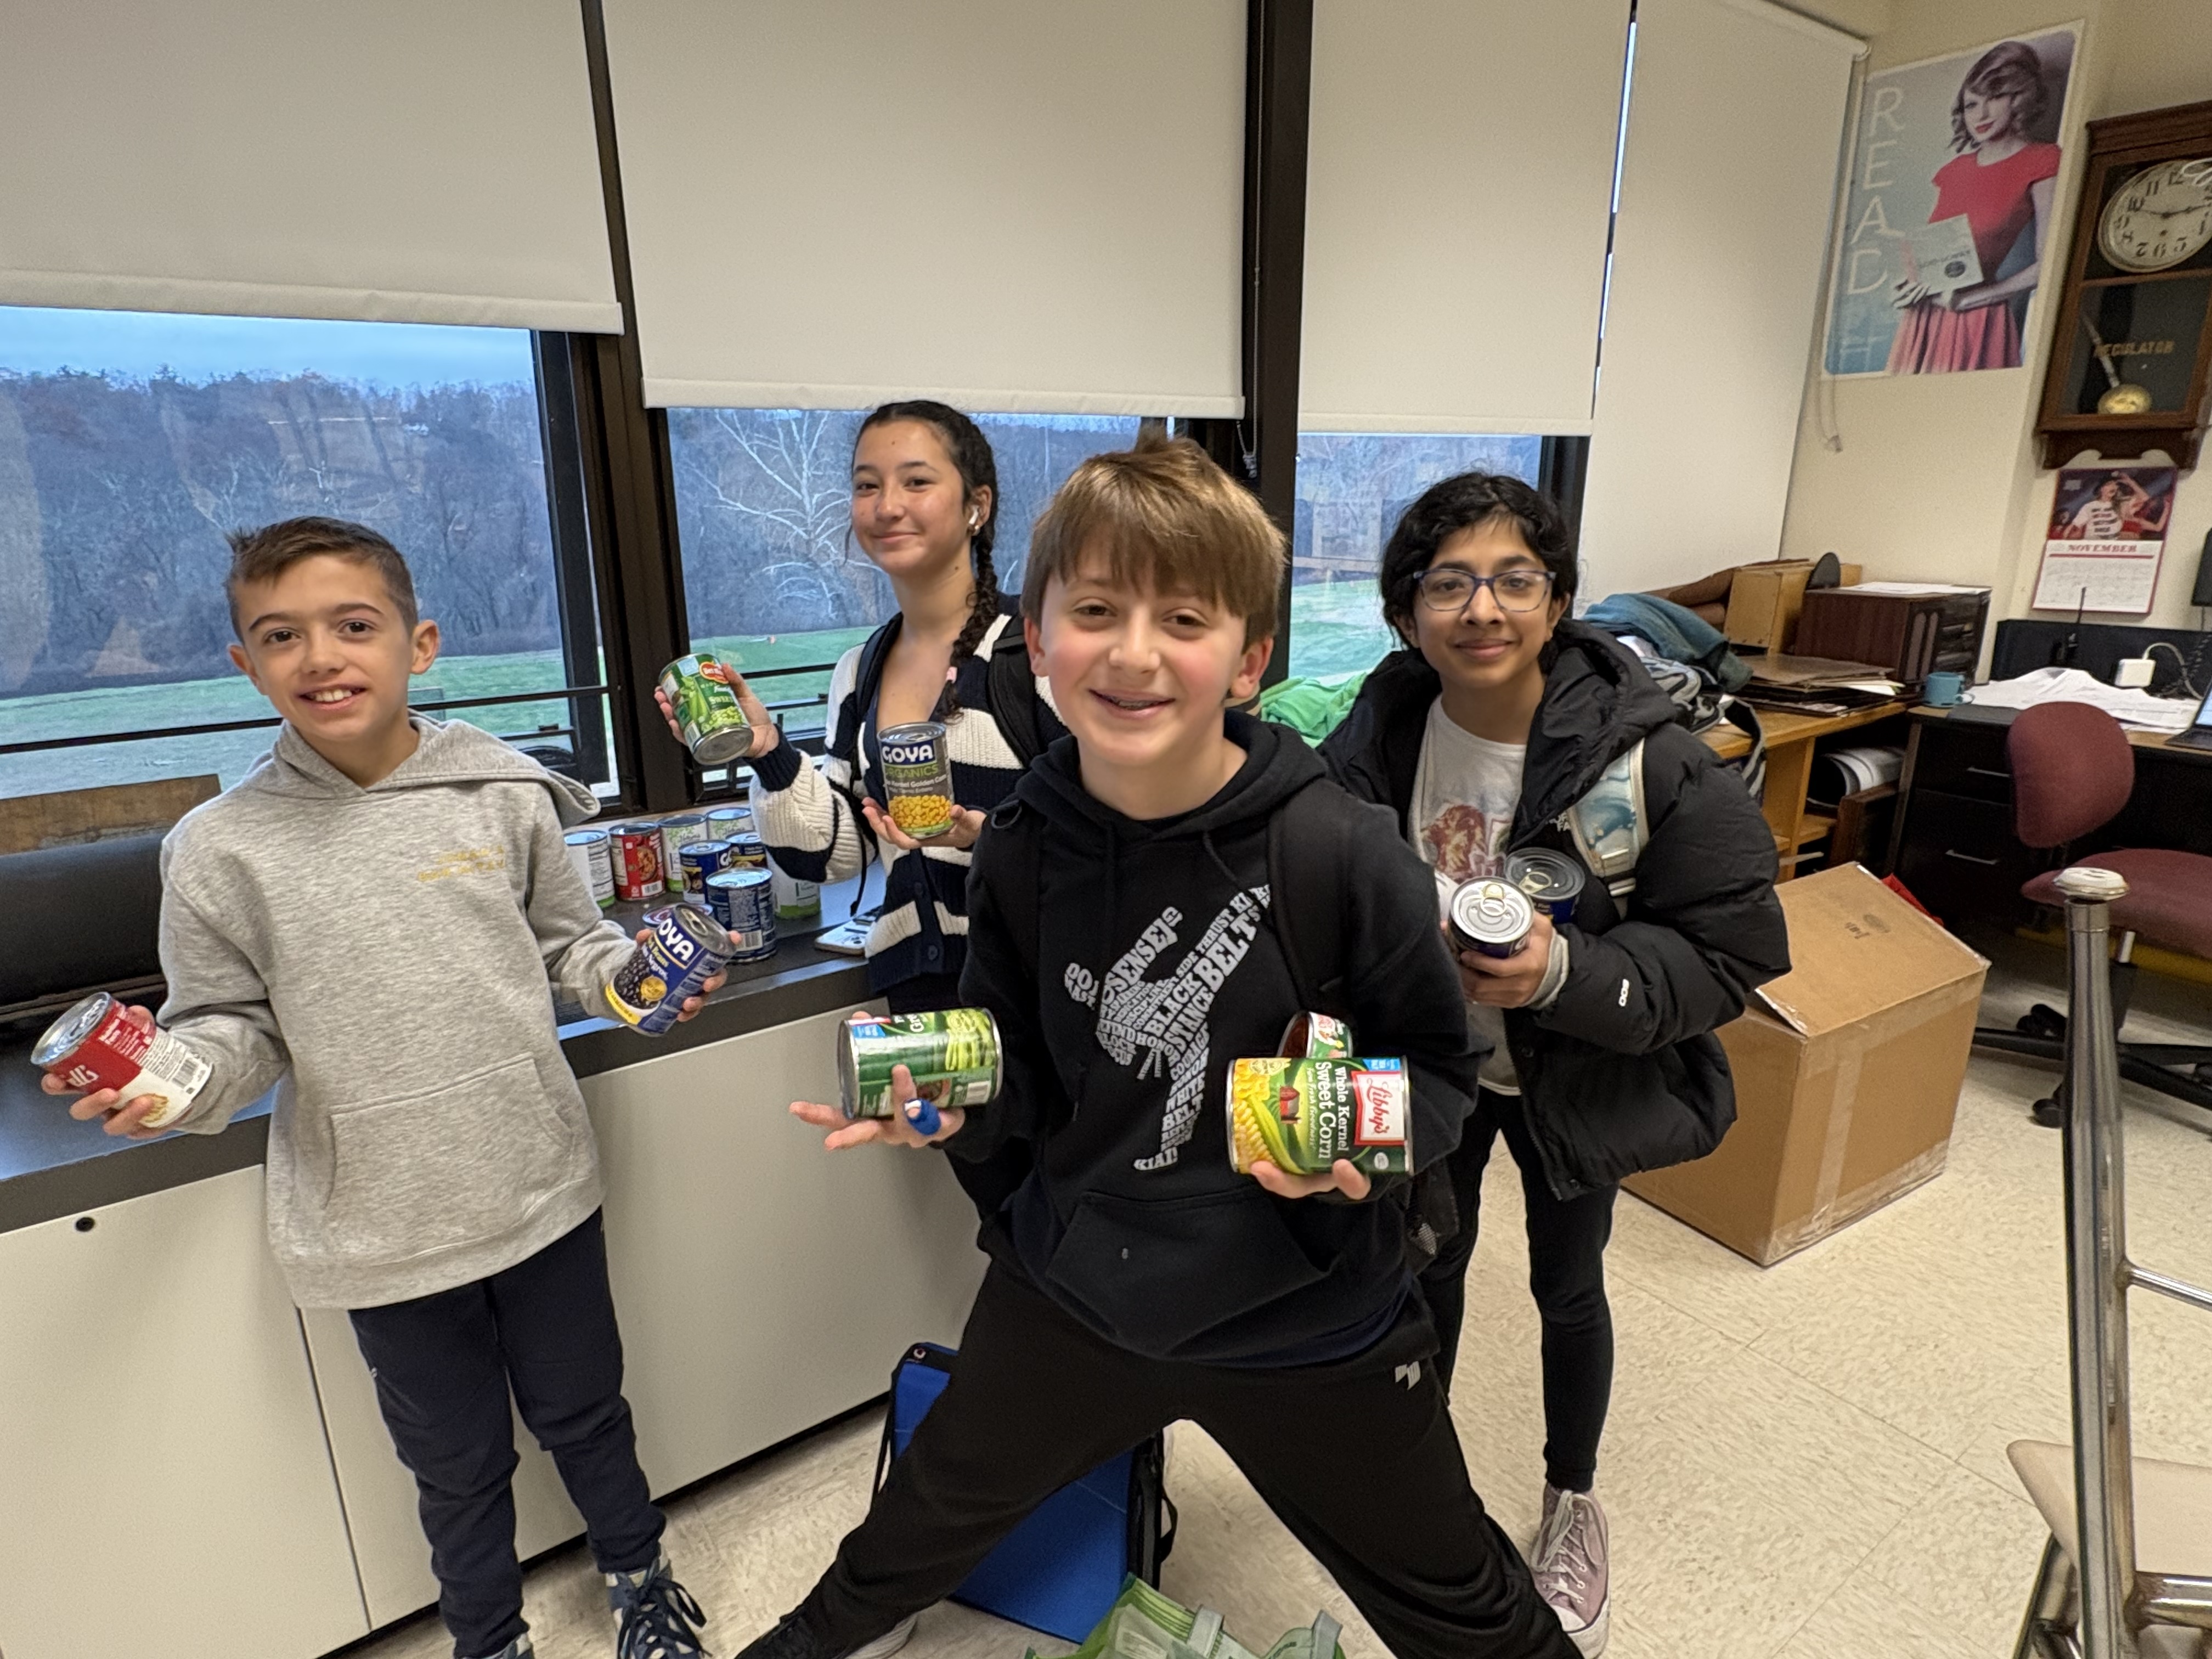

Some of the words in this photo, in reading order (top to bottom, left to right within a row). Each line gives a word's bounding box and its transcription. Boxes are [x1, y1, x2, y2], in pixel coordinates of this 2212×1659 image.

[1848, 86, 1905, 295] READ
[2094, 340, 2175, 357] REGULATOR
[2067, 544, 2137, 553] NOVEMBER
[881, 744, 934, 764] GOYA
[658, 918, 695, 962] OYA
[1105, 917, 1179, 992] SENSEI
[1176, 951, 1199, 978] SIDE
[1195, 908, 1235, 954] THRUST
[1143, 972, 1203, 1037] BLACK
[1193, 912, 1257, 994] BELT
[1164, 986, 1215, 1053] STANCE
[1136, 1031, 1180, 1067] HONOR
[1165, 1071, 1206, 1114] WHITE
[1316, 1061, 1335, 1110] Sweet
[1334, 1066, 1348, 1103] Whole
[1365, 1077, 1393, 1134] Libby's
[1161, 1092, 1204, 1132] BELT
[1318, 1111, 1337, 1159] Corn
[1337, 1104, 1350, 1152] Kernel
